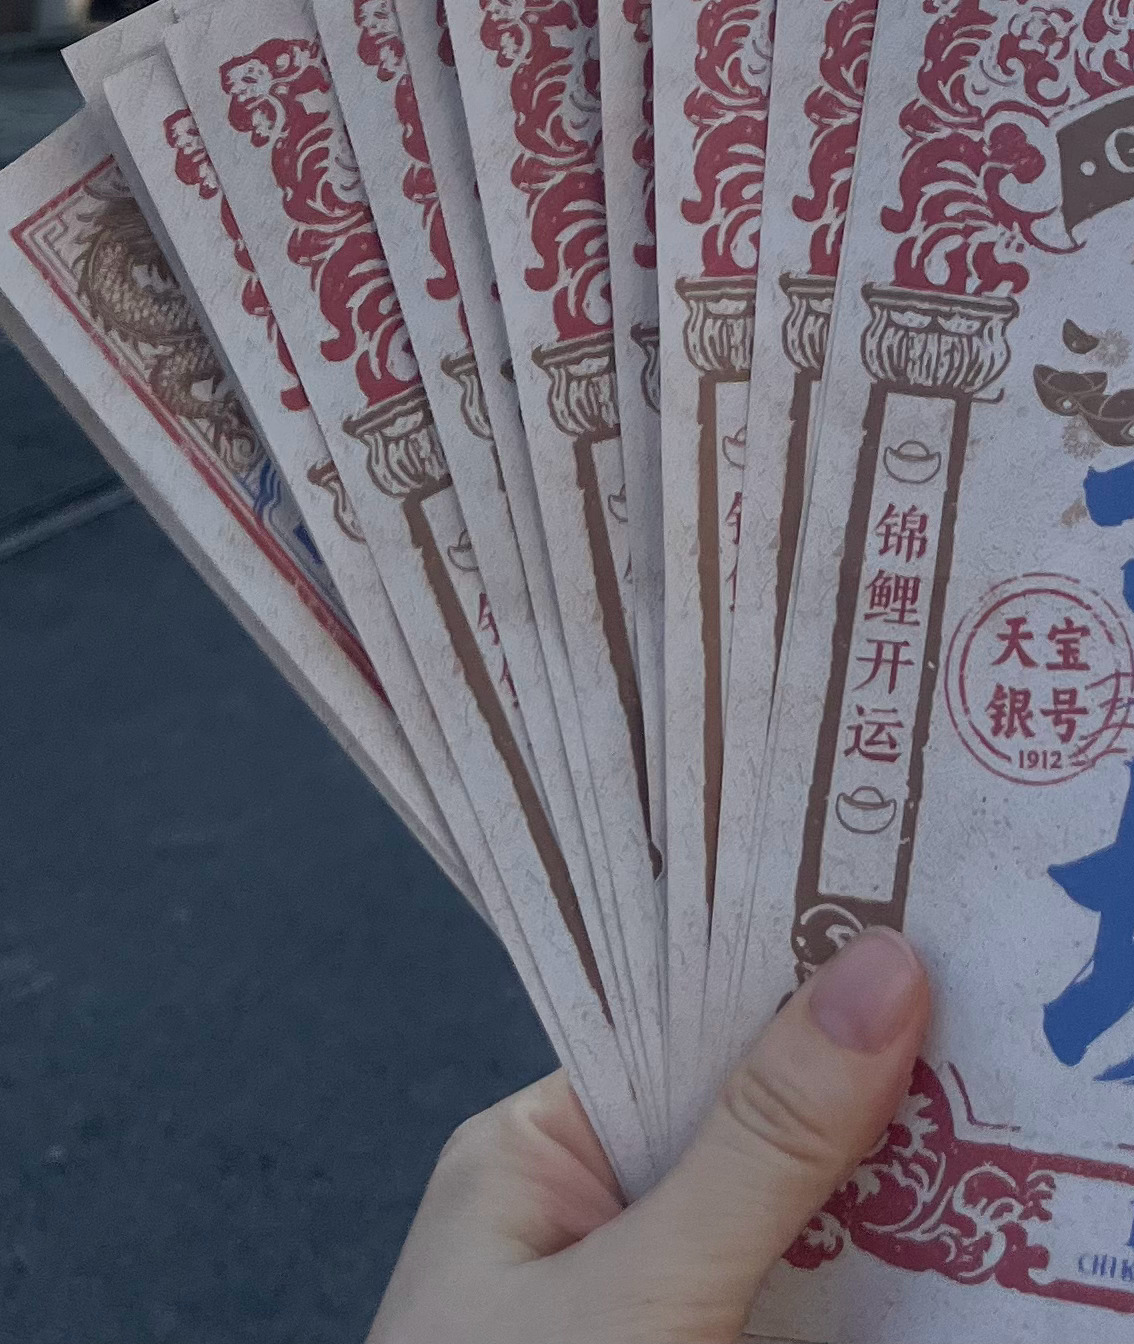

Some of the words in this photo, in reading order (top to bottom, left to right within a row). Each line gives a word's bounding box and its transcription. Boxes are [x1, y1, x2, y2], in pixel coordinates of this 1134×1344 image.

[843, 502, 931, 764] 锦鲤开运
[1018, 749, 1064, 770] 1912
